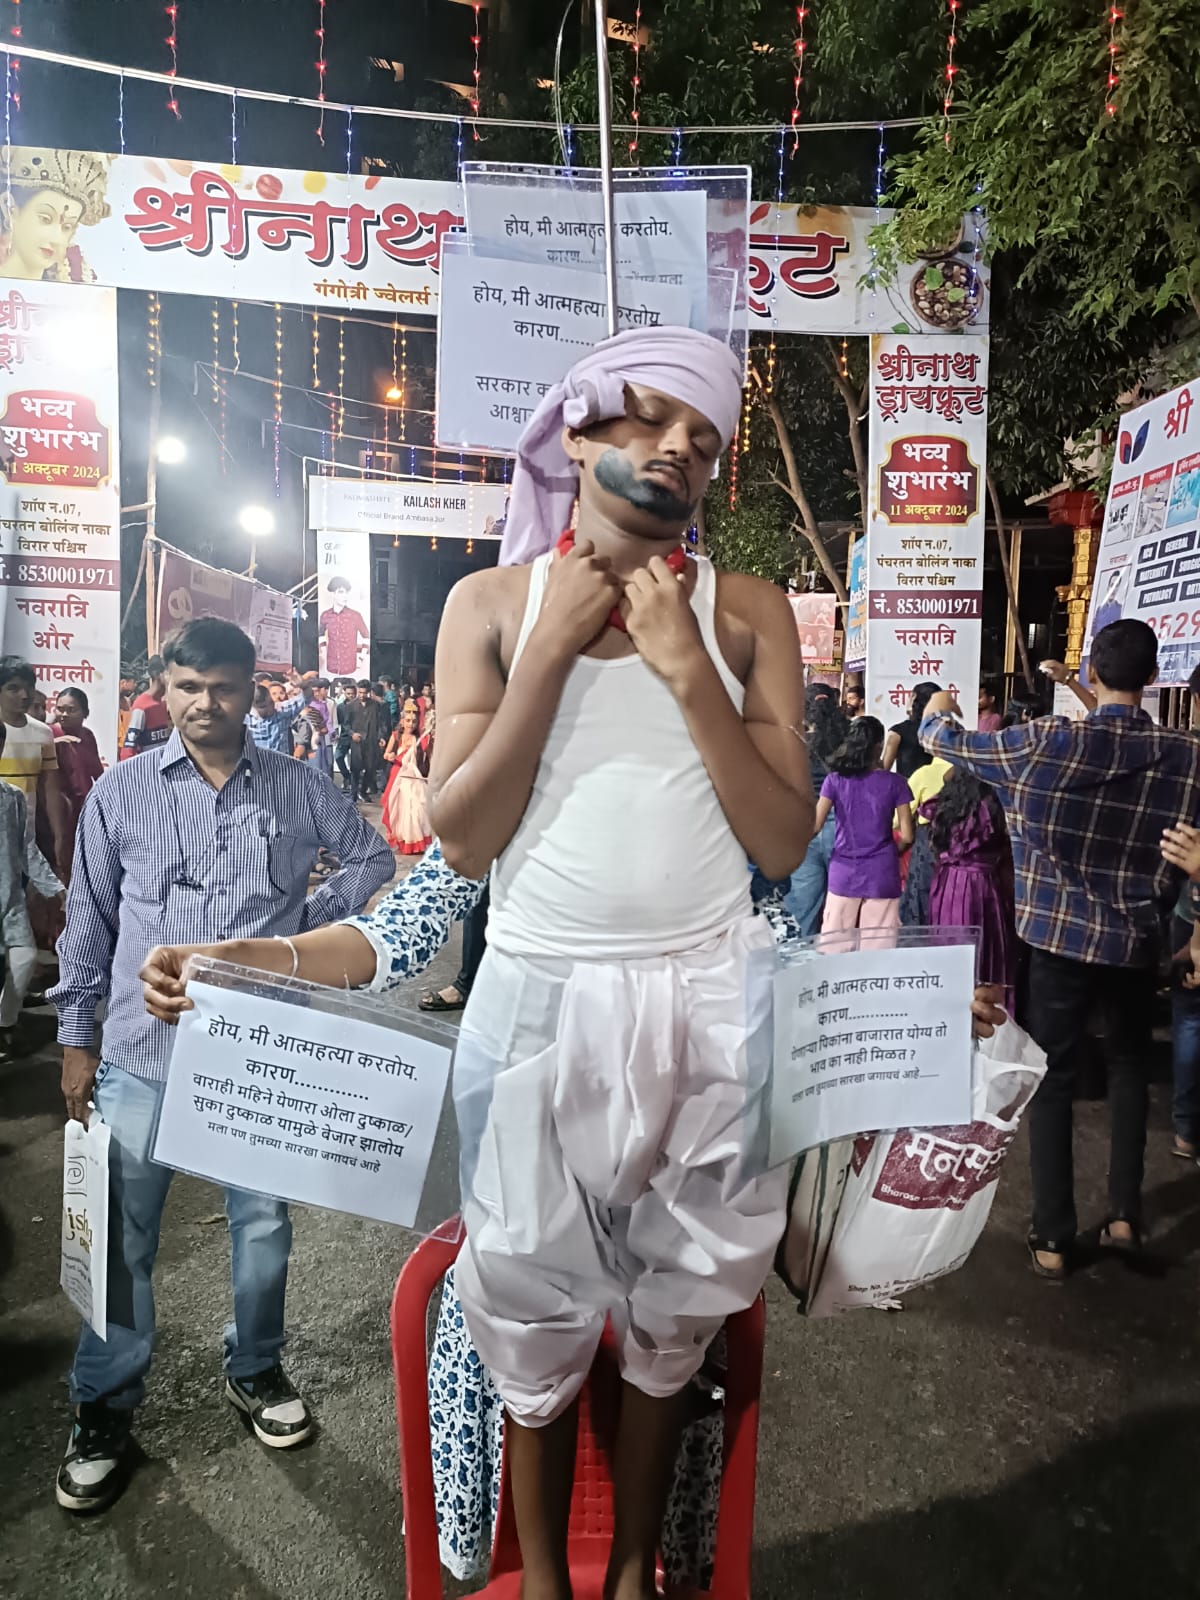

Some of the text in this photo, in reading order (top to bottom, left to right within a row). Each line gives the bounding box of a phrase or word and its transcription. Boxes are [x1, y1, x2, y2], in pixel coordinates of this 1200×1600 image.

[124, 170, 465, 272] श्रीनाथ
[504, 214, 534, 238] होय,
[536, 216, 552, 235] मी
[620, 216, 672, 237] करतोय.
[314, 278, 370, 300] गंगोत्री
[373, 283, 430, 305] ज्वेलर्स
[473, 281, 507, 306] होय,
[512, 286, 530, 306] मी
[534, 293, 606, 318] आत्महत्या
[877, 344, 980, 382] श्रीनाथ
[476, 376, 531, 396] सरकार
[20, 396, 77, 420] भव्य
[490, 404, 535, 424] आश्वा
[875, 385, 988, 424] ड्रायफ्रूट
[1, 423, 102, 457] शुभारंभ
[902, 443, 950, 462] भव्य
[23, 462, 70, 481] अक्टूबर
[73, 465, 100, 479] 2024
[884, 464, 972, 500] शुभारंभ
[21, 498, 45, 513] शॉप
[403, 495, 440, 509] KAILASH
[443, 498, 466, 510] KHER
[890, 504, 968, 520] 11 अक्टूबर 2024
[82, 524, 111, 536] नाका
[17, 536, 88, 554] विरार पश्चिम
[901, 536, 922, 550] शॉप
[876, 554, 913, 568] पंचरतन
[952, 557, 977, 568] नाका
[18, 564, 115, 586] 8530001971
[897, 572, 956, 586] विरार पश्चिम
[15, 594, 89, 619] नवरात्रि
[873, 592, 891, 614] नं.
[897, 598, 978, 615] 8530001971
[33, 623, 73, 650] और
[895, 624, 957, 646] नवरात्रि
[32, 659, 95, 684] पावली
[909, 651, 943, 676] और
[817, 980, 829, 999] मी
[831, 977, 890, 995] आत्महत्या
[893, 970, 944, 990] करतोय.
[906, 1023, 933, 1040] योग्य
[935, 1021, 947, 1037] तो
[207, 1015, 419, 1083] होय, मी आत्महत्या करतोय.
[828, 1055, 842, 1068] का
[844, 1047, 868, 1065] नाही
[870, 1046, 907, 1062] मिळत
[237, 1084, 274, 1105] महिने
[276, 1090, 318, 1115] येणारा
[320, 1102, 355, 1124] ओला
[193, 1095, 224, 1113] सुका
[226, 1104, 275, 1126] दुष्काळ
[277, 1119, 319, 1138] यामुळे
[359, 1136, 404, 1158] झालोय
[207, 1121, 229, 1136] मला
[230, 1127, 247, 1141] पण
[249, 1132, 282, 1150] तुमच्या
[284, 1141, 319, 1158] सारखा
[360, 1159, 381, 1174] आहे
